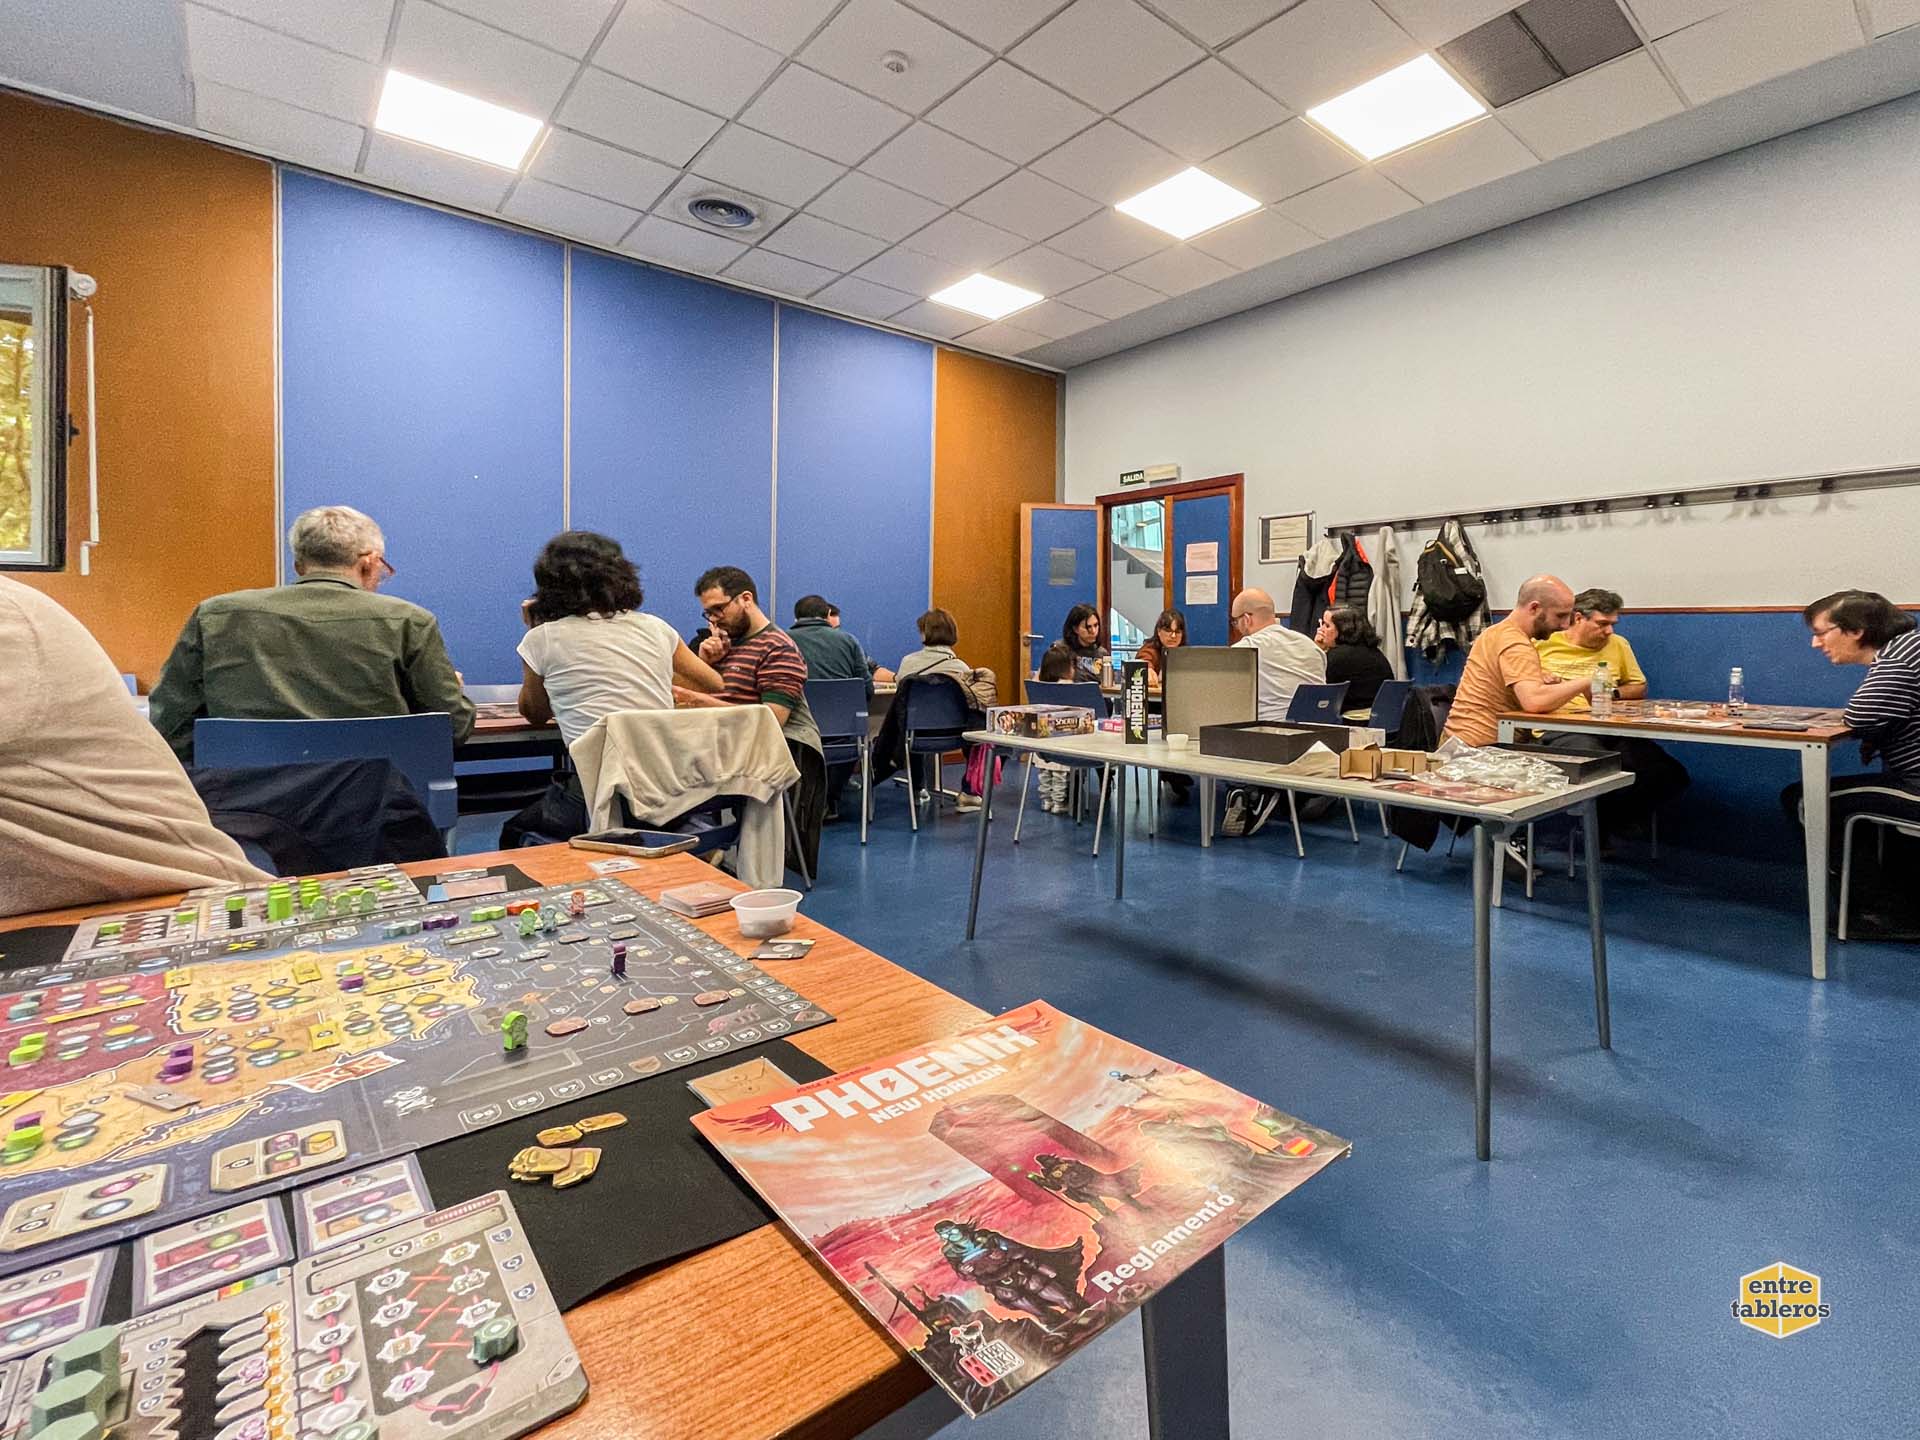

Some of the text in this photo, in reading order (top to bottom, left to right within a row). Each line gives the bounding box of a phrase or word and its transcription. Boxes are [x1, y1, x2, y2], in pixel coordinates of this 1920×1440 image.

[1122, 472, 1144, 483] SALIDA
[1131, 677, 1143, 730] PHOENIX
[770, 1025, 1039, 1133] PHOENIX
[868, 1063, 1009, 1125] NEW HORIZON
[1091, 1193, 1235, 1293] Reglamento
